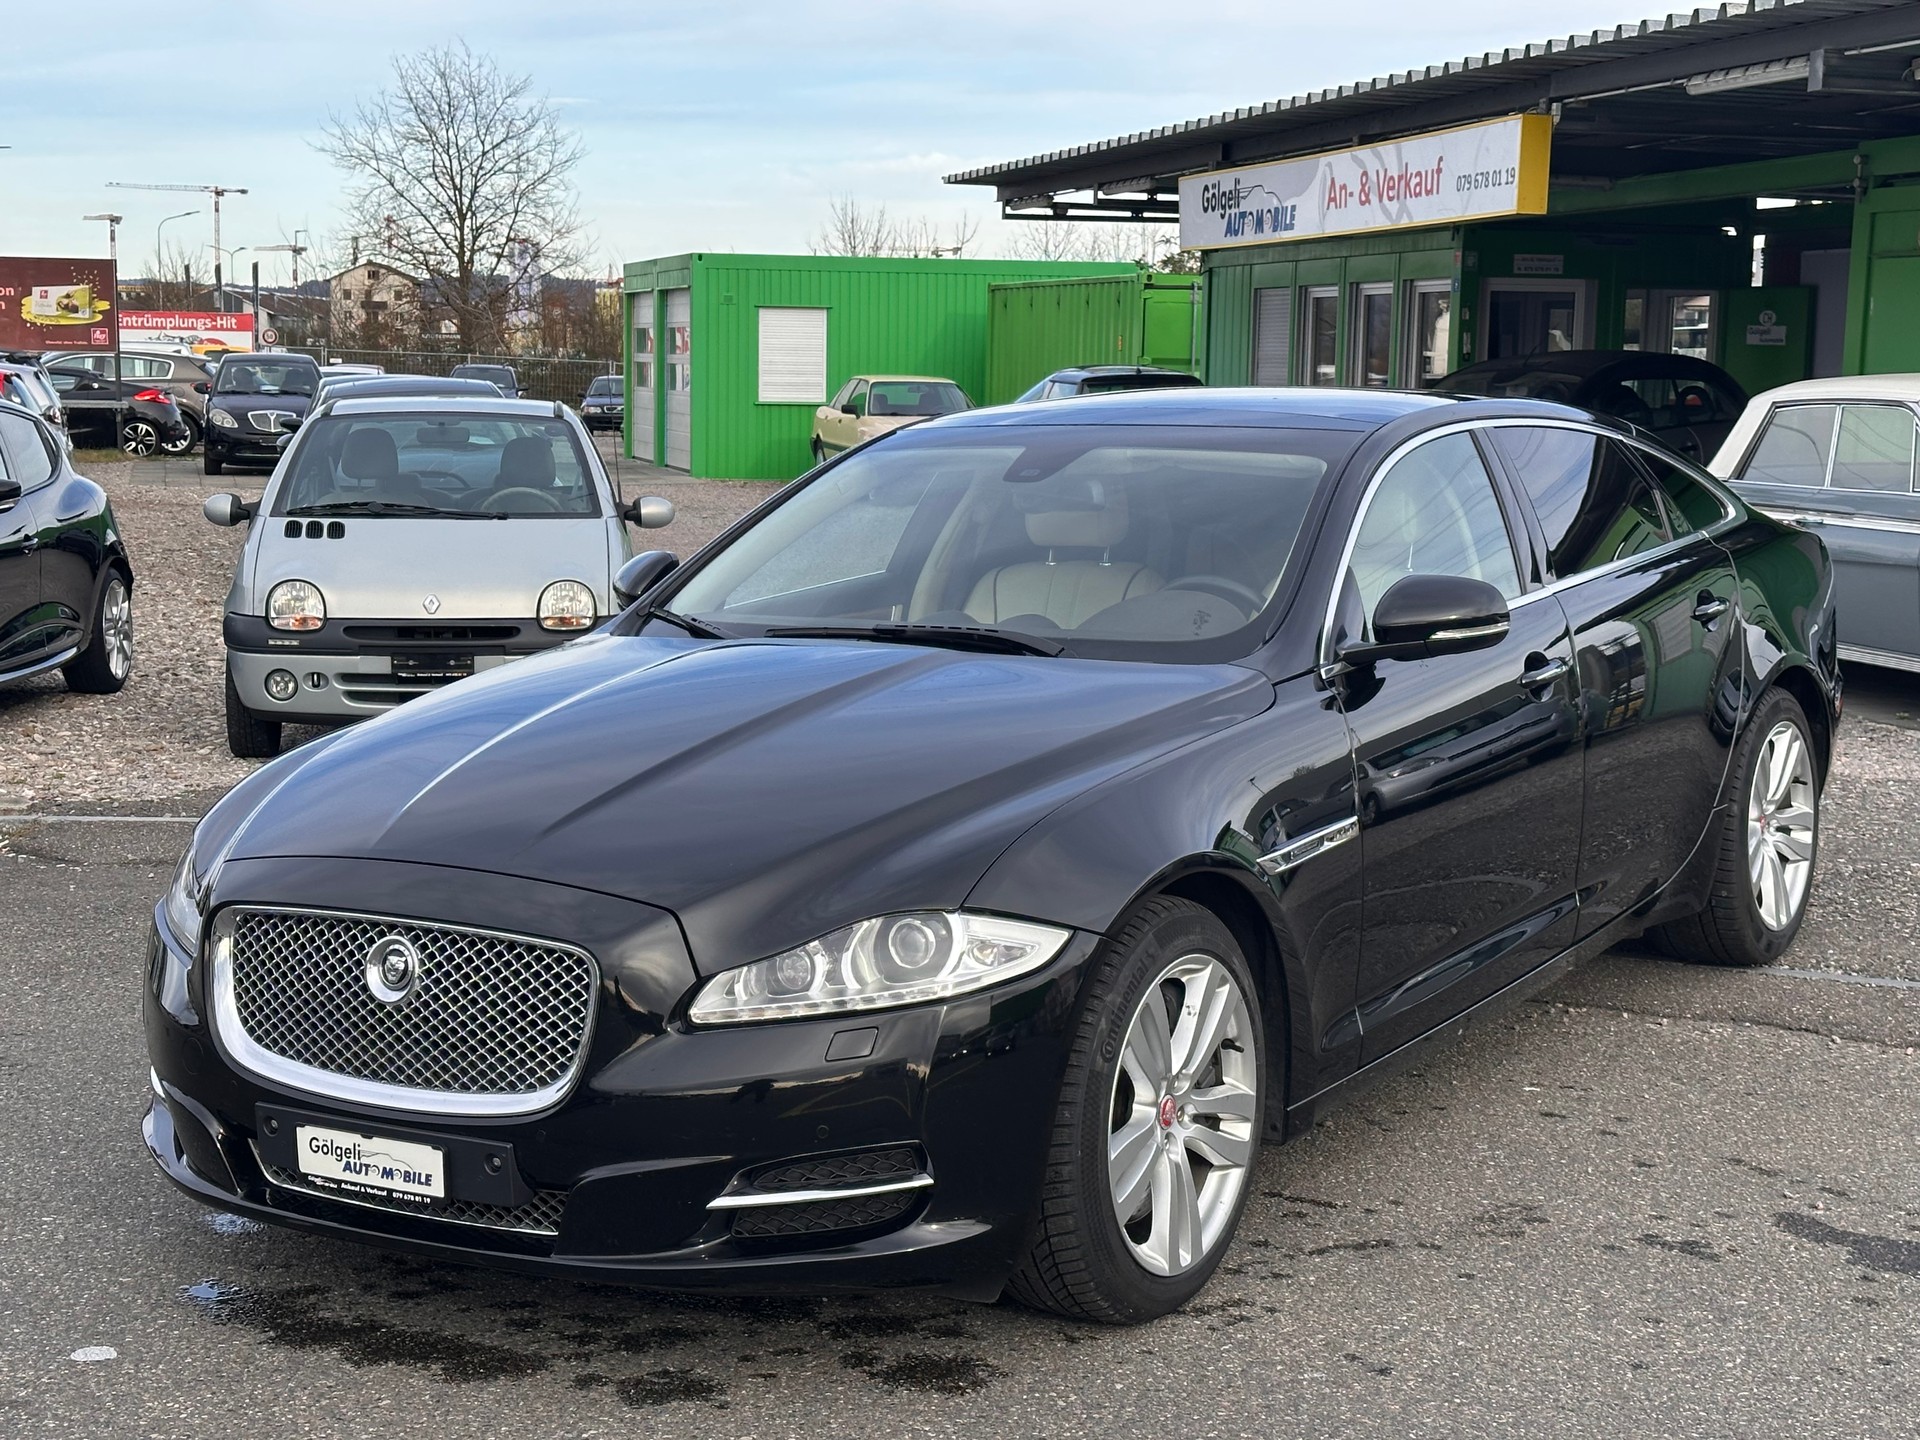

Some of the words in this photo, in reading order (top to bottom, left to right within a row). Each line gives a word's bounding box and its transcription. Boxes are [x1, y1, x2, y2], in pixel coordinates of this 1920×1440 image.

[1201, 177, 1241, 220] Gölgeli
[1326, 177, 1354, 210] An-
[1358, 170, 1372, 207] &
[1375, 155, 1444, 204] Verkauf
[1456, 173, 1473, 192] 079
[1473, 170, 1490, 190] 678
[1491, 169, 1503, 187] 01
[1505, 167, 1516, 186] 19
[308, 1135, 362, 1163] Gölgeli
[366, 1187, 388, 1197] Verkauf
